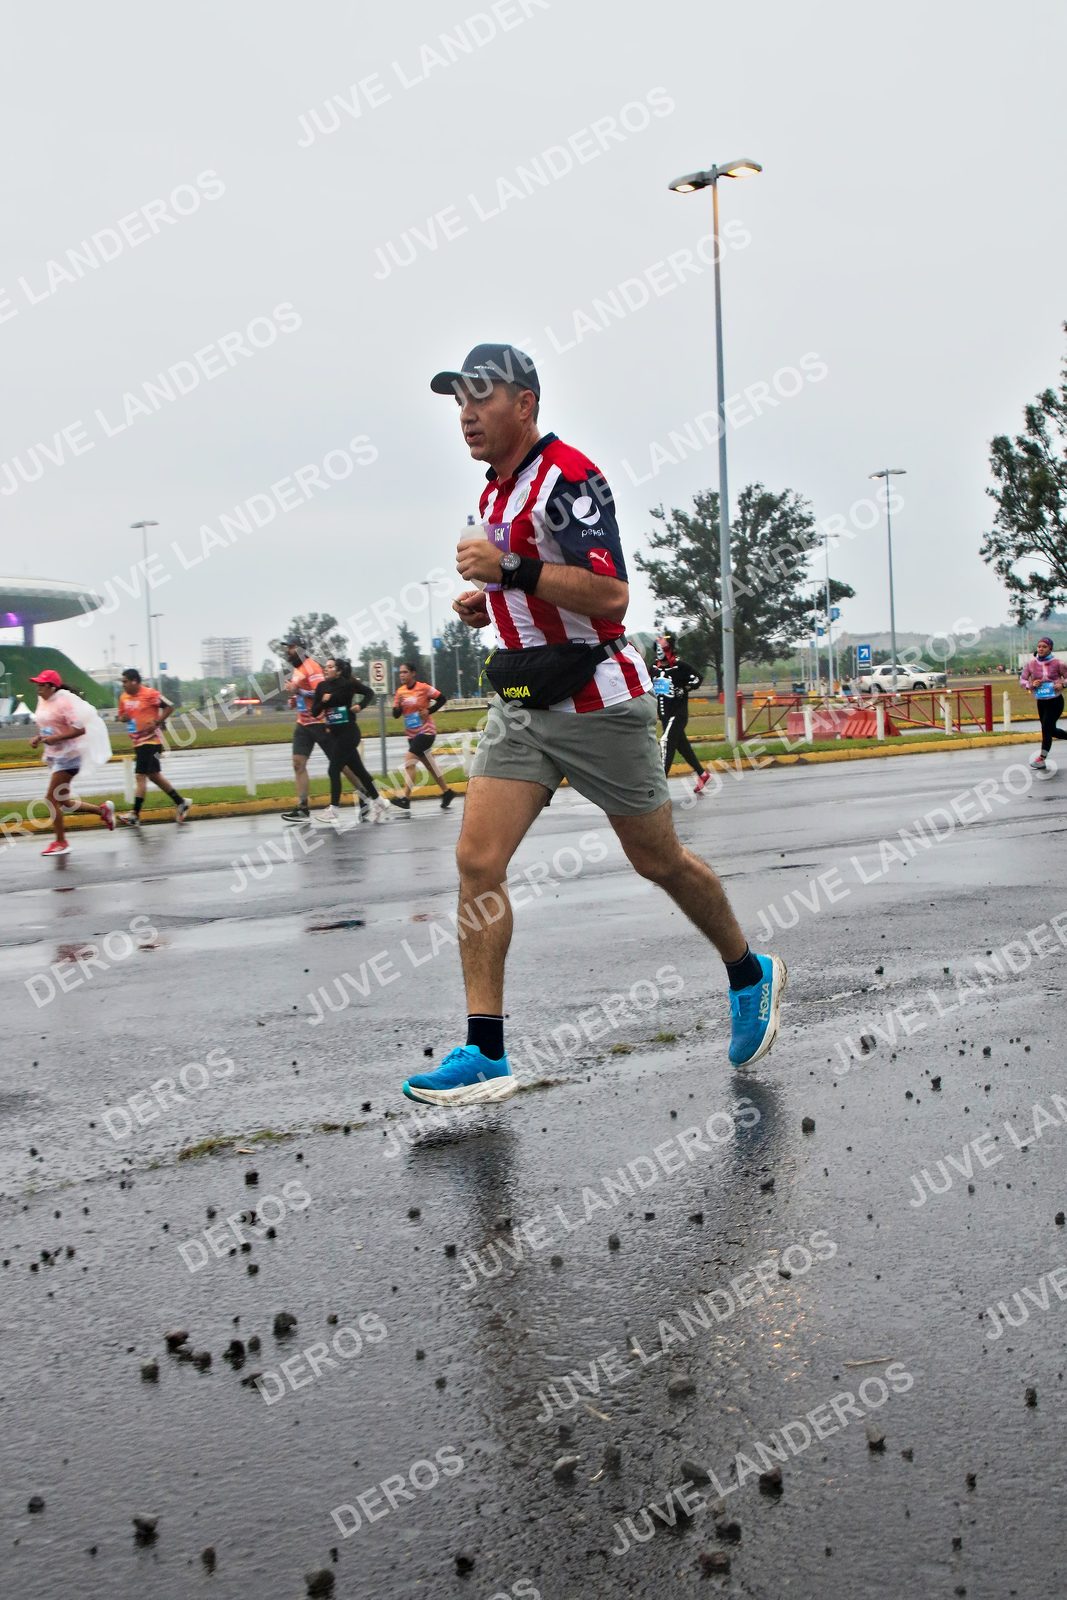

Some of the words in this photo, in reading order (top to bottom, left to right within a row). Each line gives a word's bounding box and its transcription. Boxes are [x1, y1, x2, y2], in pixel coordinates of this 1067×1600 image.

[494, 527, 505, 541] 15K
[502, 685, 531, 698] HOKA
[758, 982, 770, 1021] HOKA
